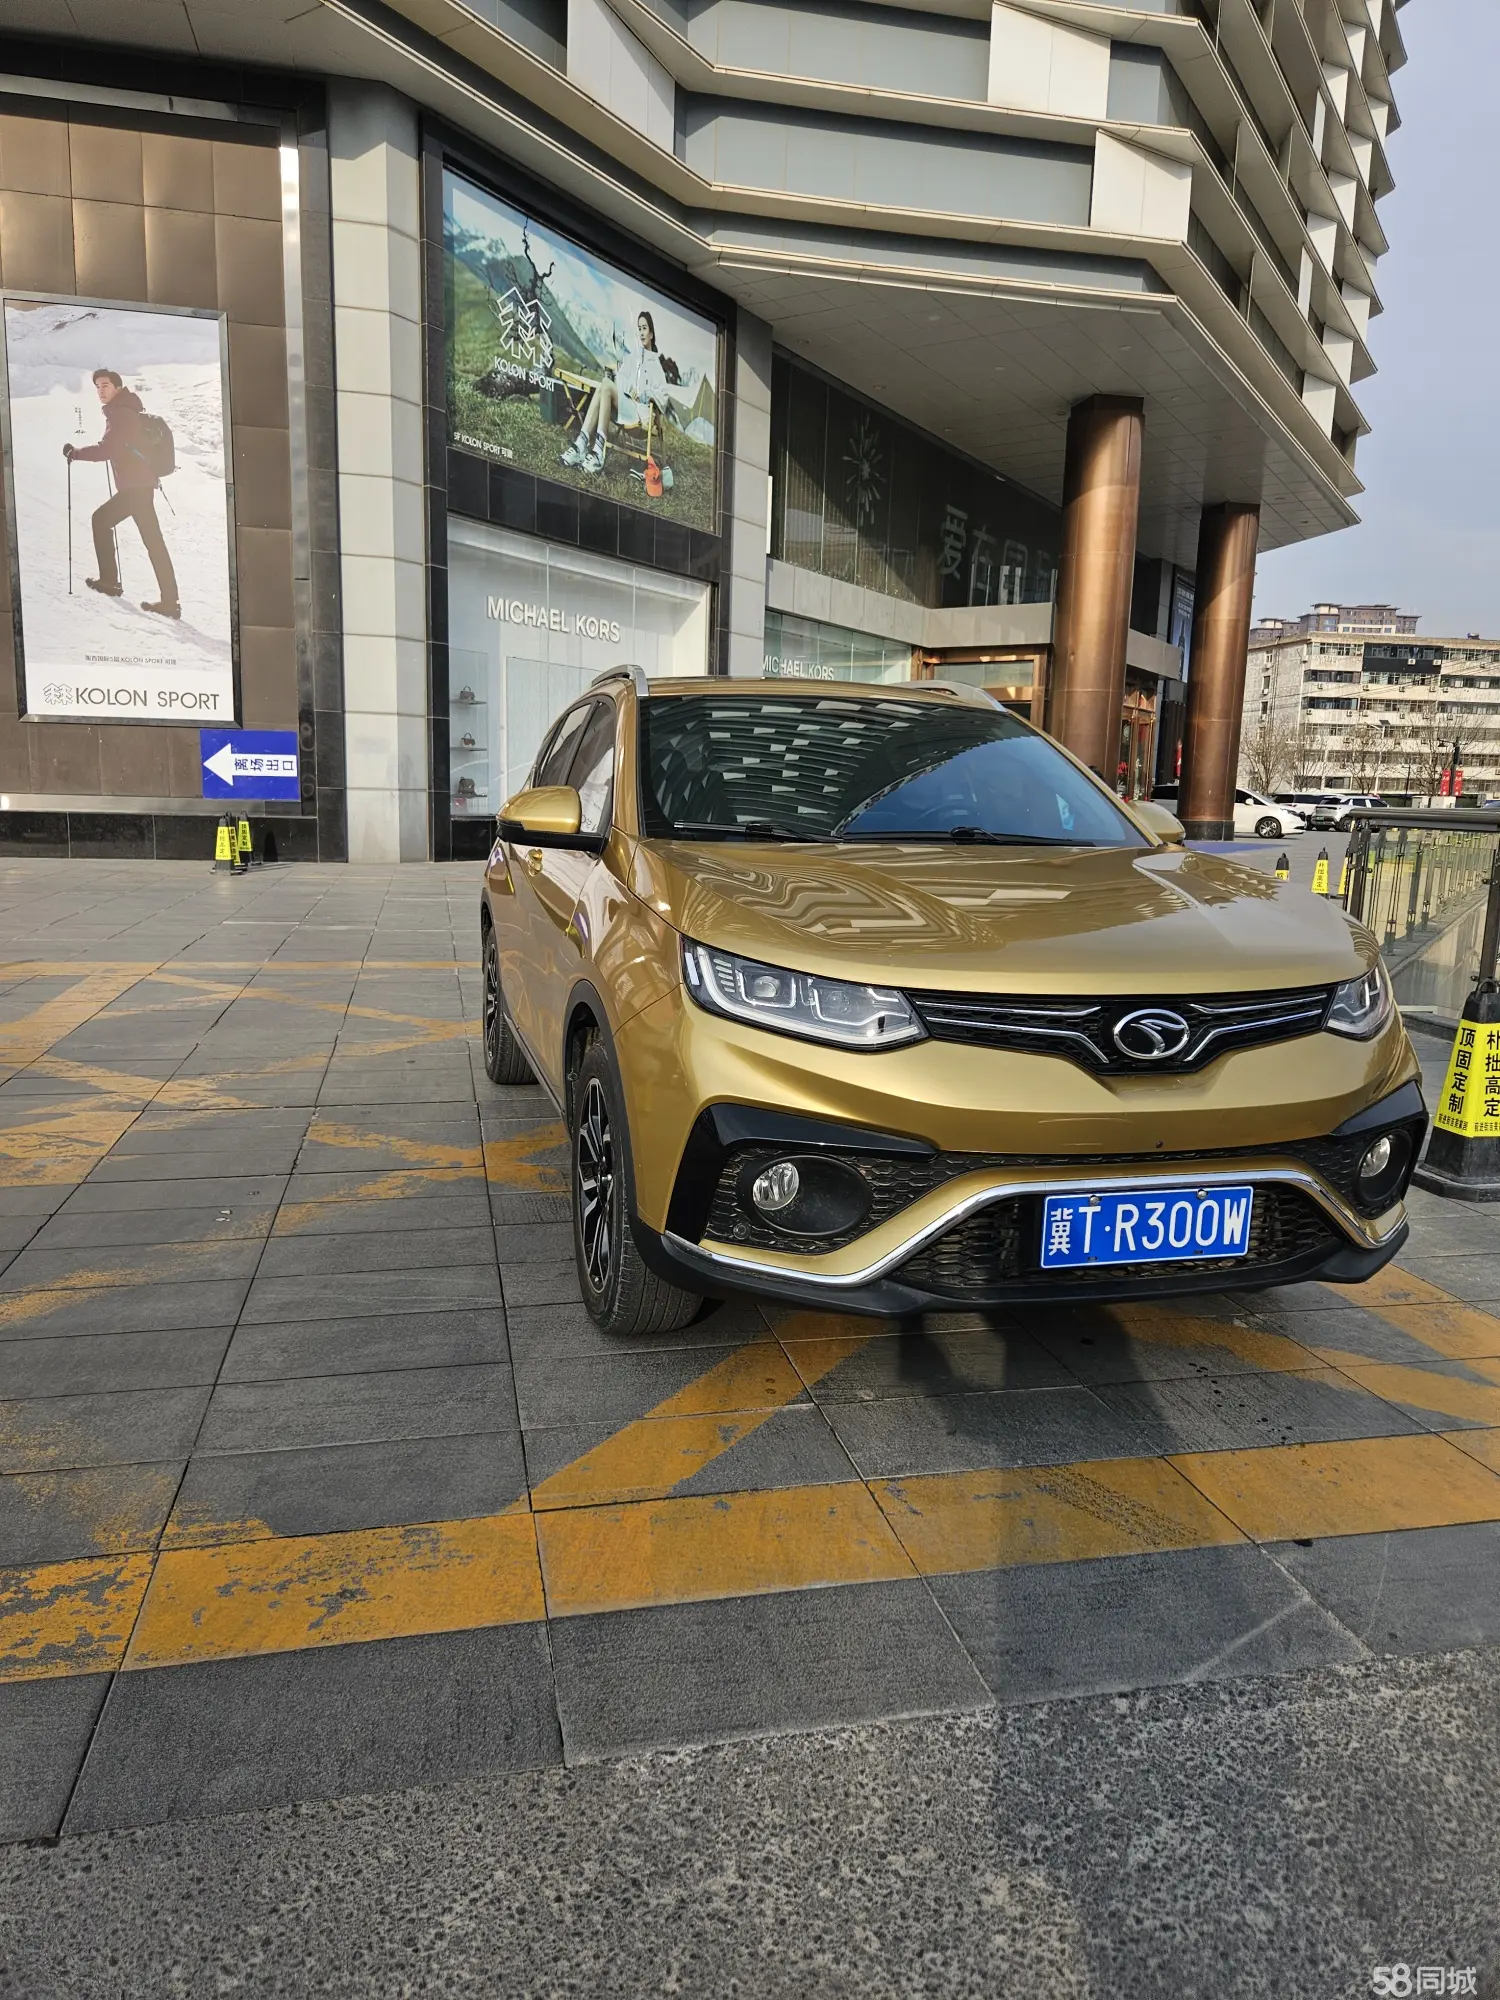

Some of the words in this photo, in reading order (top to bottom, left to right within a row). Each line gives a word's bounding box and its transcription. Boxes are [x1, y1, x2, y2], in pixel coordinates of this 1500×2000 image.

[494, 355, 526, 381] KOLON
[528, 370, 555, 392] SPORT
[461, 434, 482, 449] KOLON
[483, 441, 501, 455] SPORT
[487, 595, 570, 633] MICHAEL
[575, 613, 621, 643] KORS
[808, 663, 835, 681] KORS
[76, 687, 148, 707] KOLON
[157, 690, 220, 710] SPORT
[234, 757, 294, 772] 离场出口
[1448, 1027, 1477, 1115] 顶固定制
[1048, 1197, 1247, 1257] 冀T·R300W
